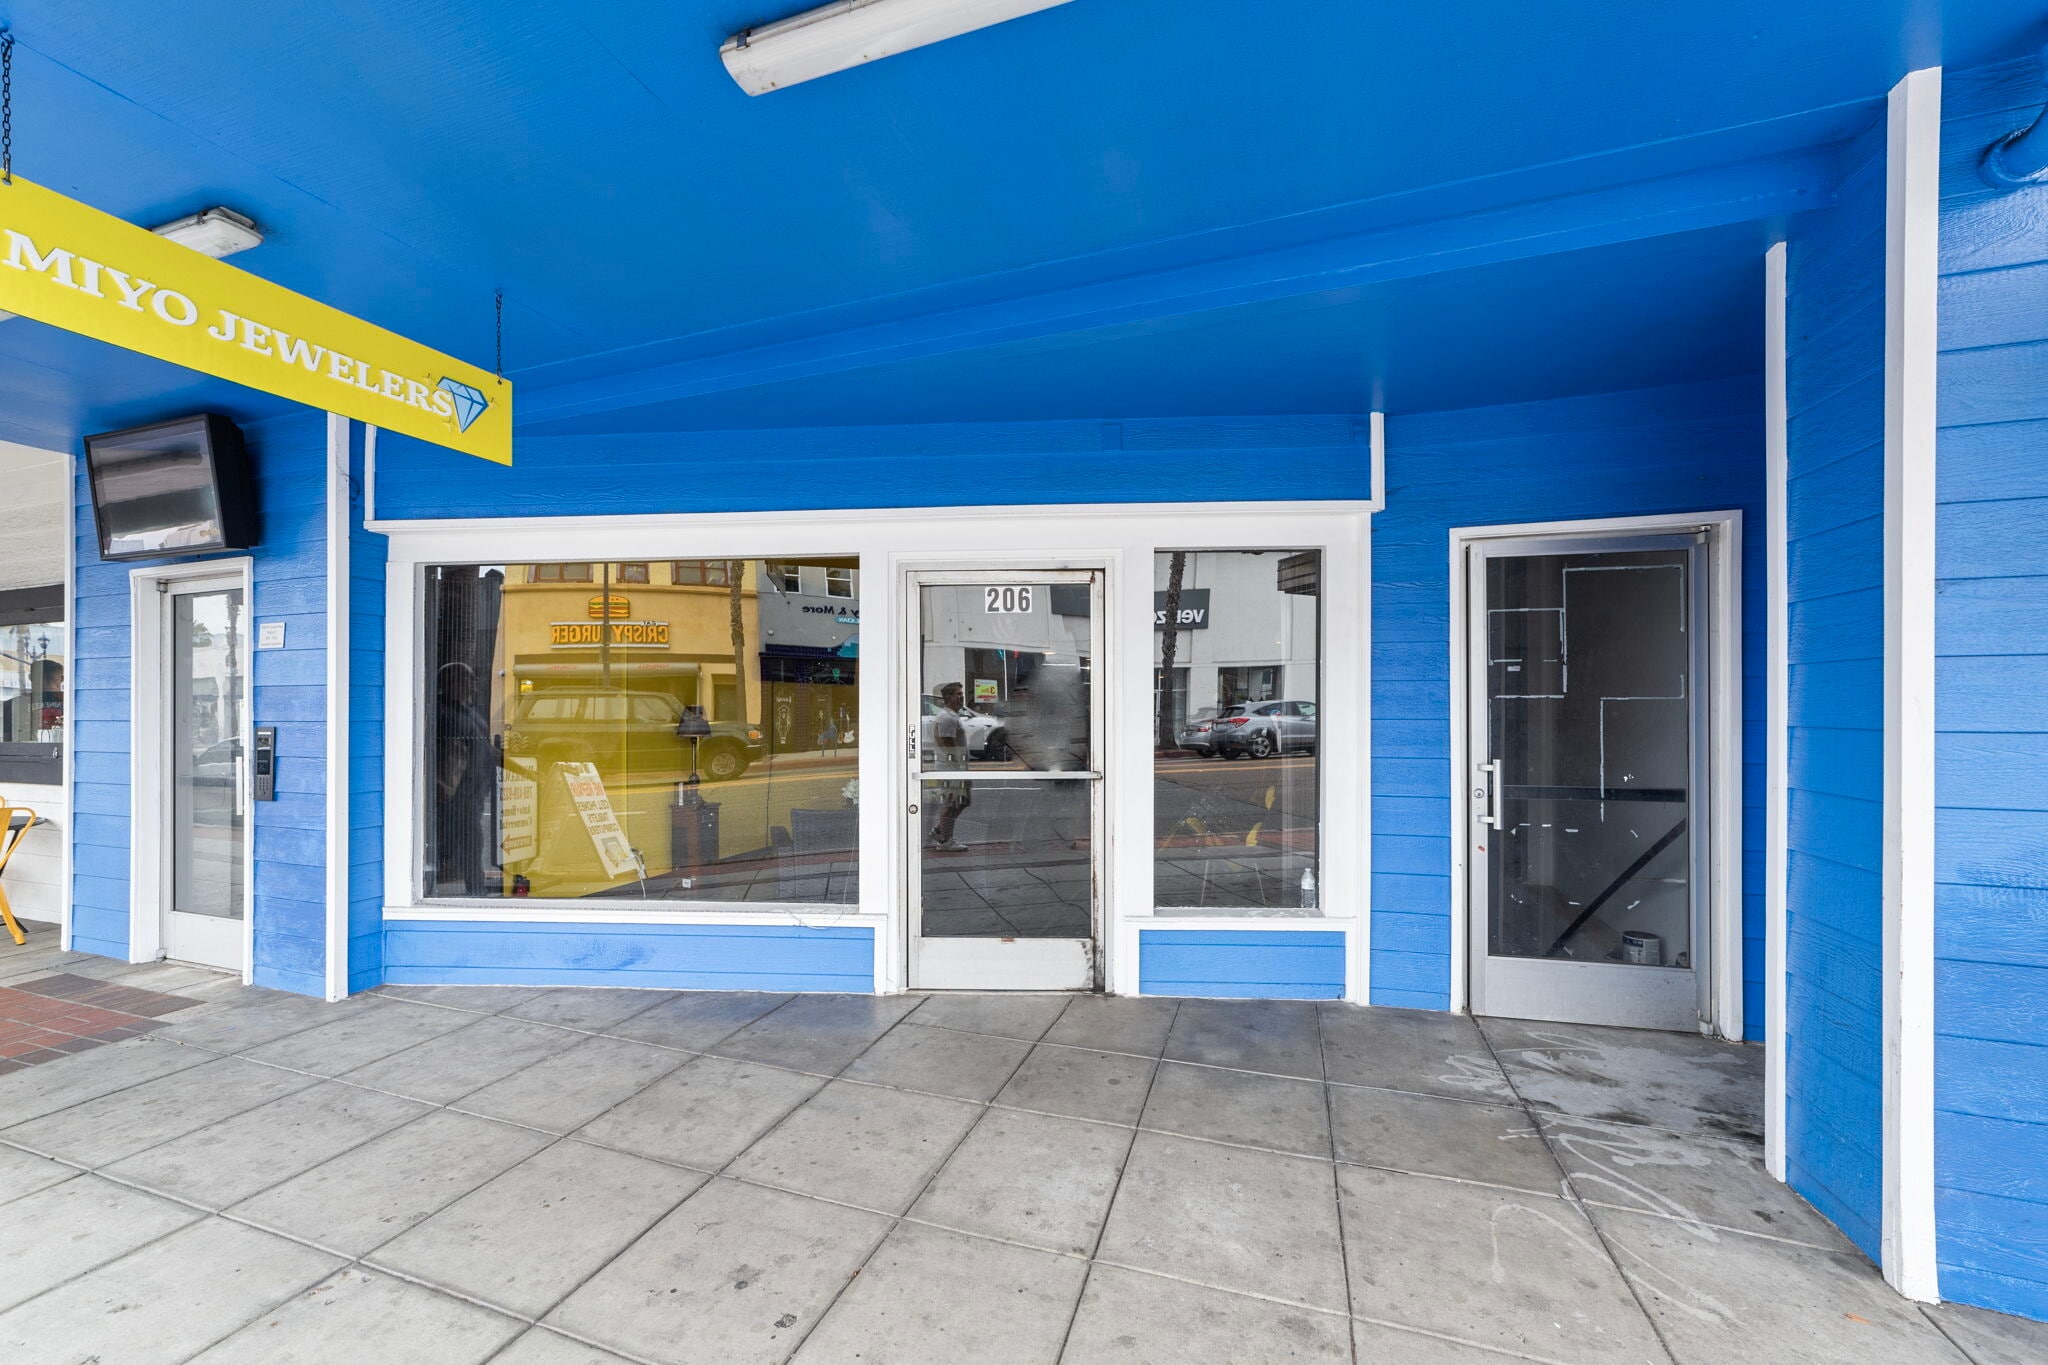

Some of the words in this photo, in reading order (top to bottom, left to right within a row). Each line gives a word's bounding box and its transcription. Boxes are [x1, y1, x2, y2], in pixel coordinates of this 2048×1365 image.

[3, 229, 198, 327] MIYO
[208, 309, 452, 418] JEWELERS
[987, 587, 1030, 612] 206
